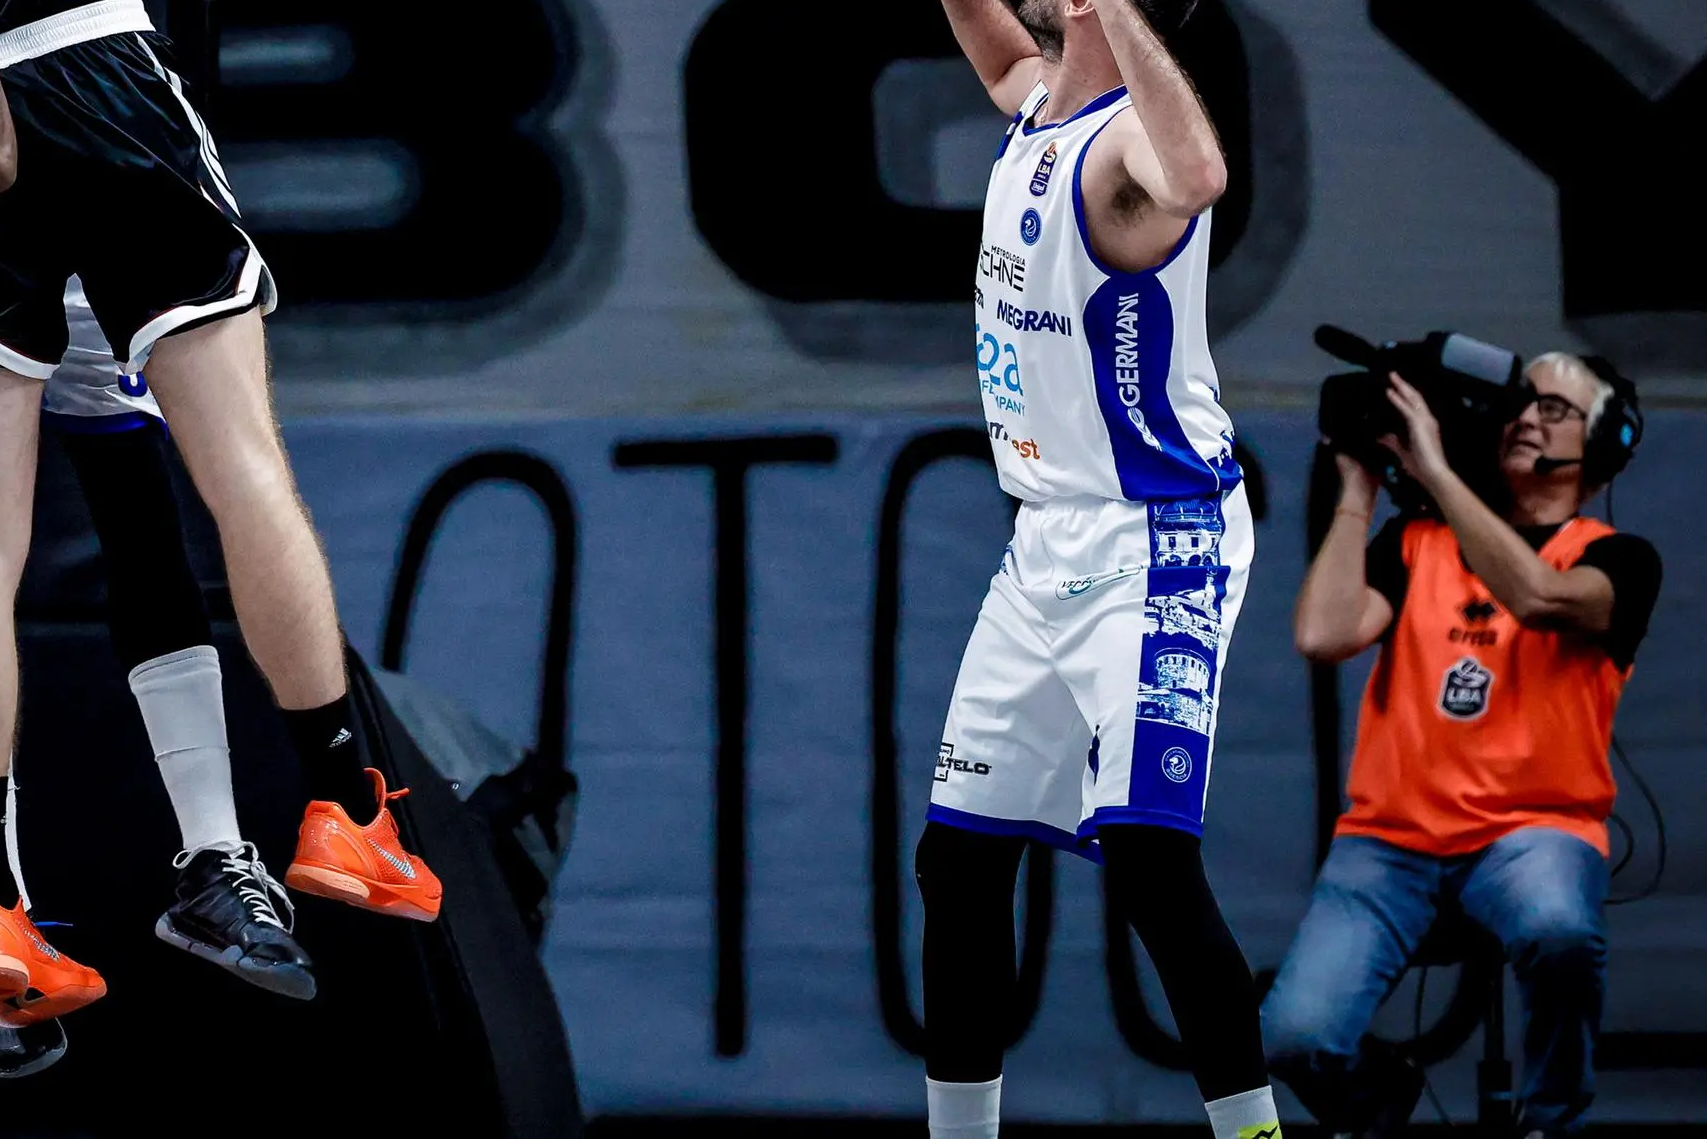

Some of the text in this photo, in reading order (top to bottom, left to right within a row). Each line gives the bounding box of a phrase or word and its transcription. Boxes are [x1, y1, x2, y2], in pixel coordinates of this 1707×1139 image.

[991, 245, 1026, 266] METROLOGIA
[996, 299, 1072, 337] MEGRANI
[1116, 292, 1140, 407] GERMANI
